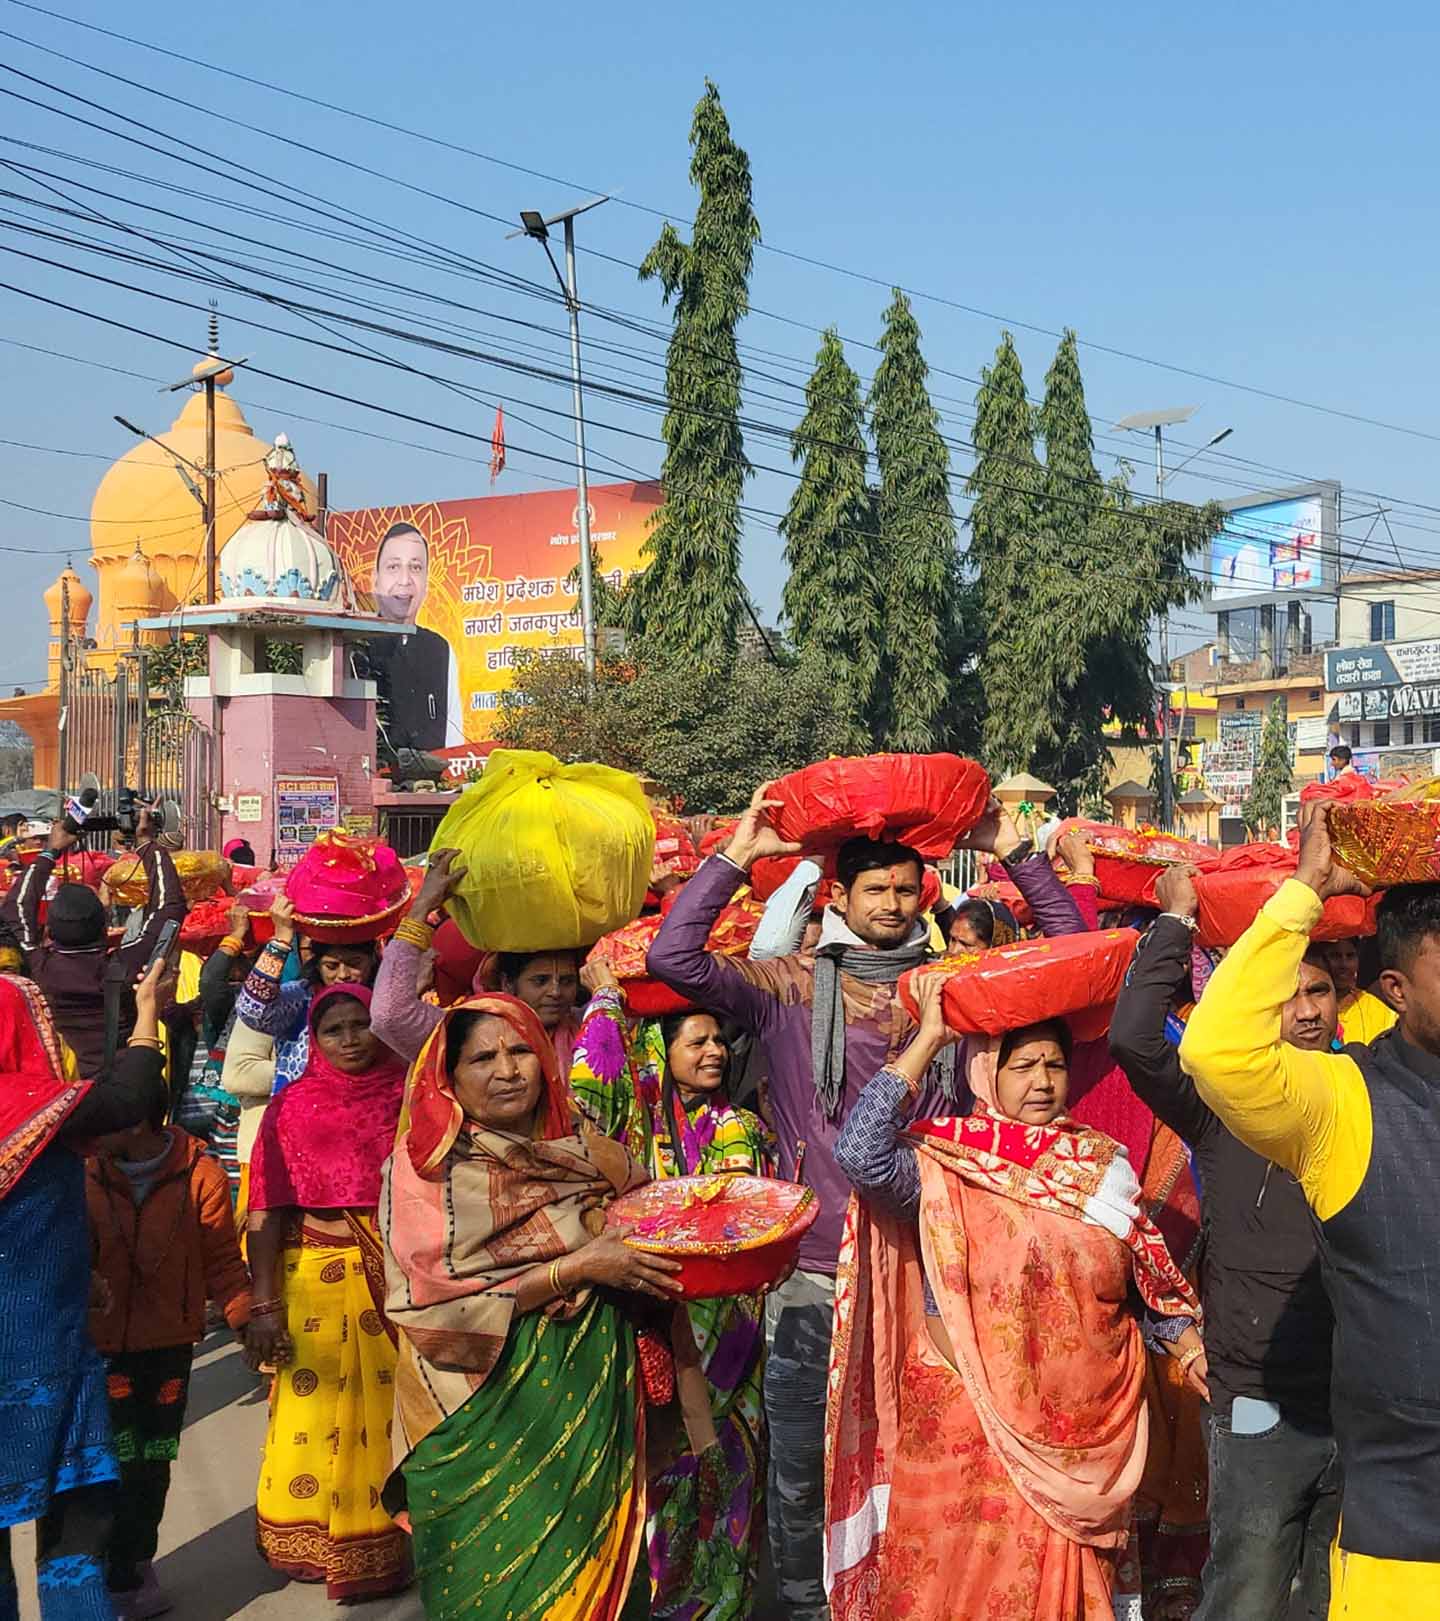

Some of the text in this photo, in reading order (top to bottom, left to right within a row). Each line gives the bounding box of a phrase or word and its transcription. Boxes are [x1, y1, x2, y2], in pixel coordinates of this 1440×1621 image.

[463, 580, 499, 602] मधेश
[504, 577, 556, 601] प्रदेशक
[464, 613, 502, 635] नगरी
